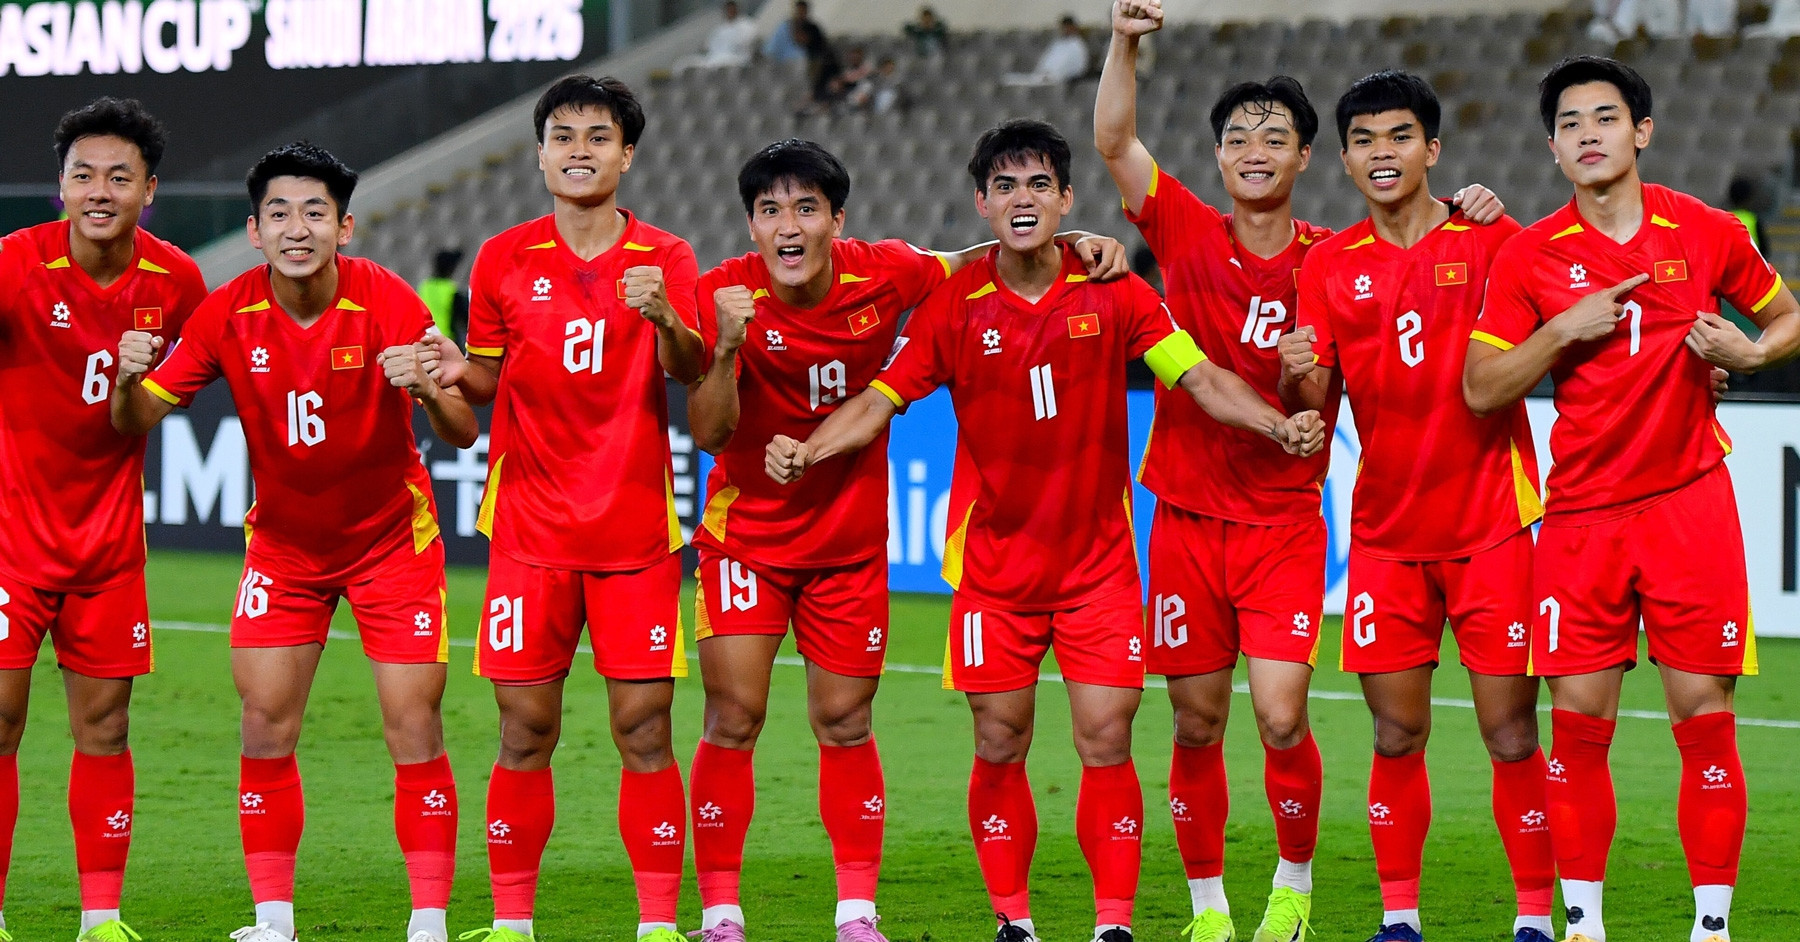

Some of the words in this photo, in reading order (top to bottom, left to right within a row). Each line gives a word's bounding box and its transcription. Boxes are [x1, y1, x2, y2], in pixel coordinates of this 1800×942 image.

[142, 0, 250, 73] CUP
[562, 317, 606, 375] 21
[1240, 295, 1286, 348] 12
[1397, 310, 1425, 367] 2
[1618, 299, 1642, 357] 7
[81, 348, 113, 405] 6
[808, 359, 847, 412] 19
[1029, 362, 1058, 421] 11
[287, 389, 326, 447] 16
[235, 566, 274, 619] 16
[719, 557, 758, 613] 19
[488, 594, 524, 653] 21
[963, 611, 984, 668] 11
[1153, 593, 1188, 649] 12
[1353, 591, 1376, 648] 2
[1539, 595, 1560, 653] 7
